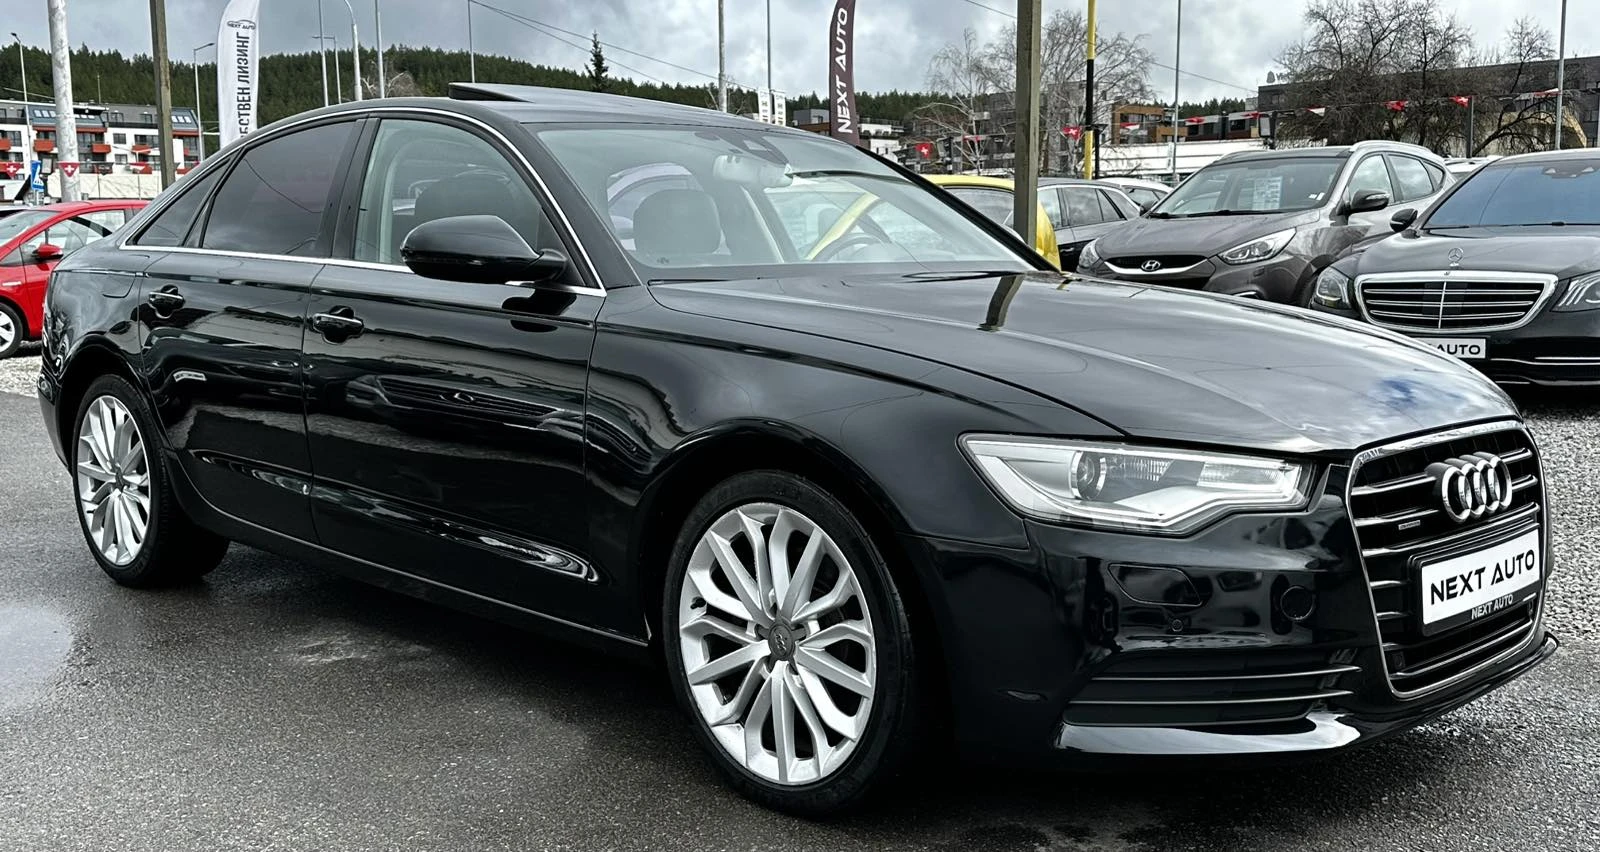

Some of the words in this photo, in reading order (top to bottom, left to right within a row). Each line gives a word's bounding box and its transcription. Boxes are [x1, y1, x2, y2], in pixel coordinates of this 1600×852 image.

[236, 31, 250, 84] ЛИЗИНГ
[835, 7, 848, 72] AUTO
[236, 86, 251, 137] БСТВЕН
[836, 74, 853, 134] NEXT
[1430, 566, 1486, 606] NEXT
[1490, 549, 1535, 586] AUTO
[1471, 602, 1493, 620] NEXT
[1493, 594, 1514, 611] AUTO
